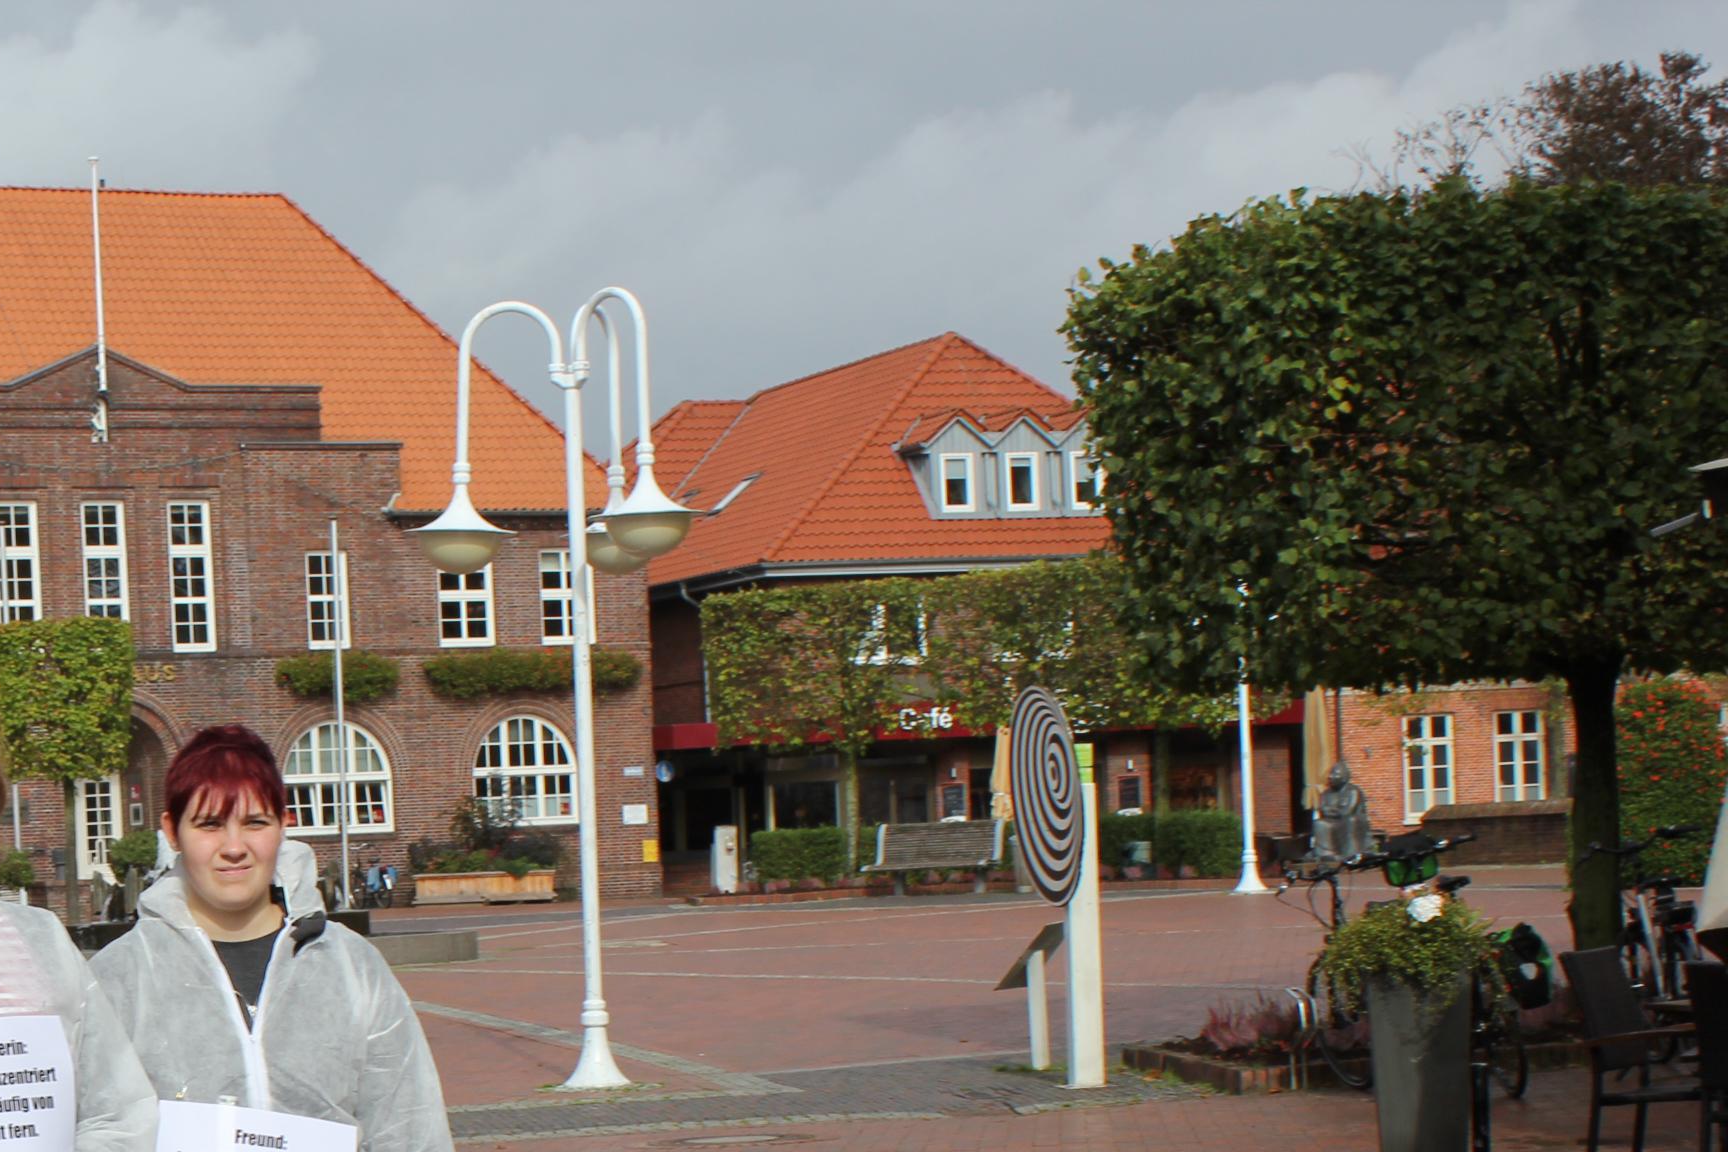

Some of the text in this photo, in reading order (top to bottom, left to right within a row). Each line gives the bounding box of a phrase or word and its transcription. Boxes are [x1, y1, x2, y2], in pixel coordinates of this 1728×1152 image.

[32, 1095, 54, 1110] von
[9, 1123, 39, 1139] fern.
[235, 1129, 288, 1150] Freund:
